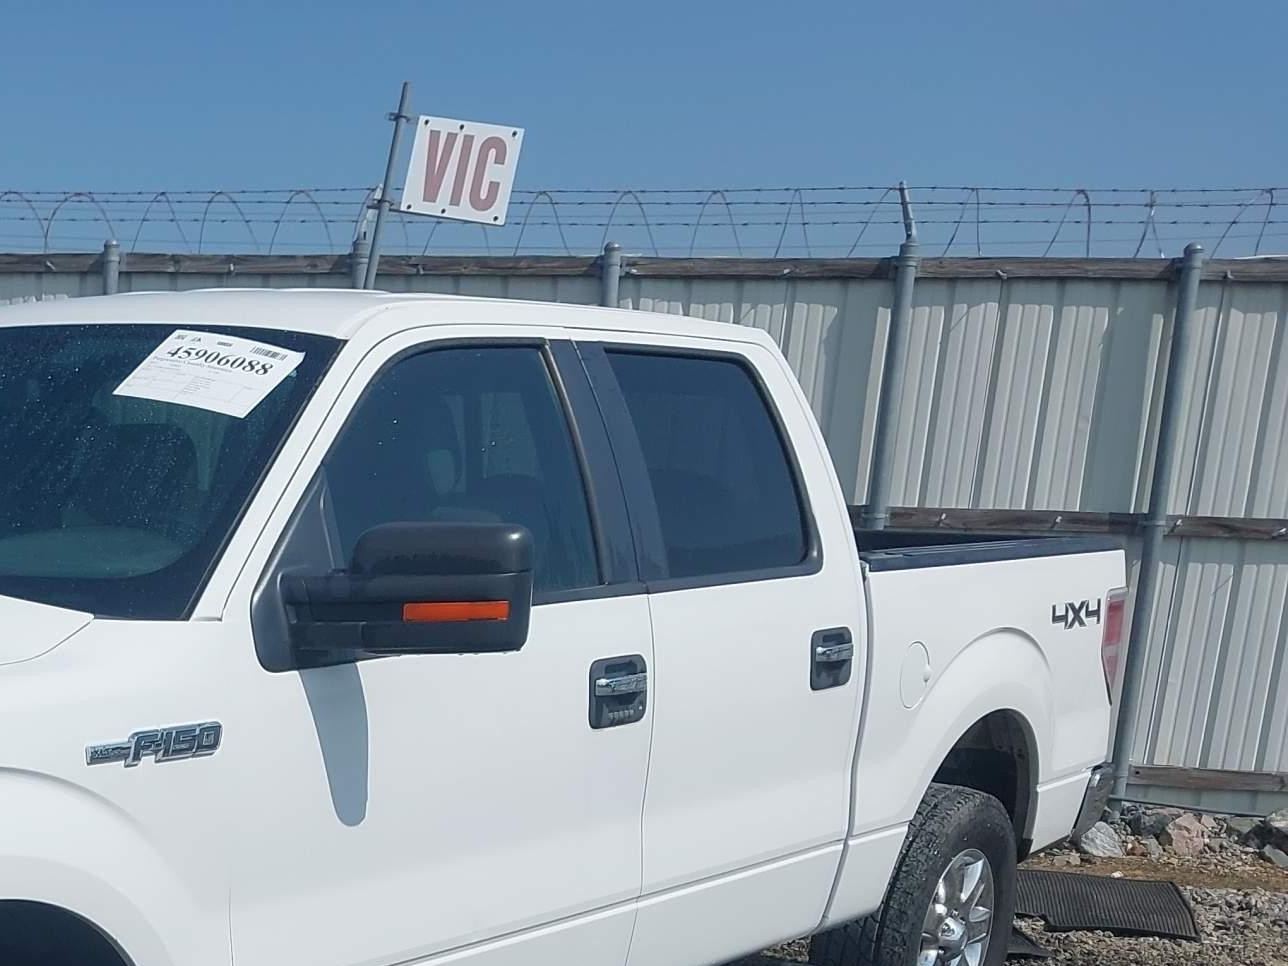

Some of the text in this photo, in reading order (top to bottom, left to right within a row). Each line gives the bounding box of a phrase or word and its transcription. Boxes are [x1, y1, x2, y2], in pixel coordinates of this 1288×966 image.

[423, 130, 507, 212] VIC
[167, 345, 274, 376] 45906088
[125, 722, 222, 767] F-150
